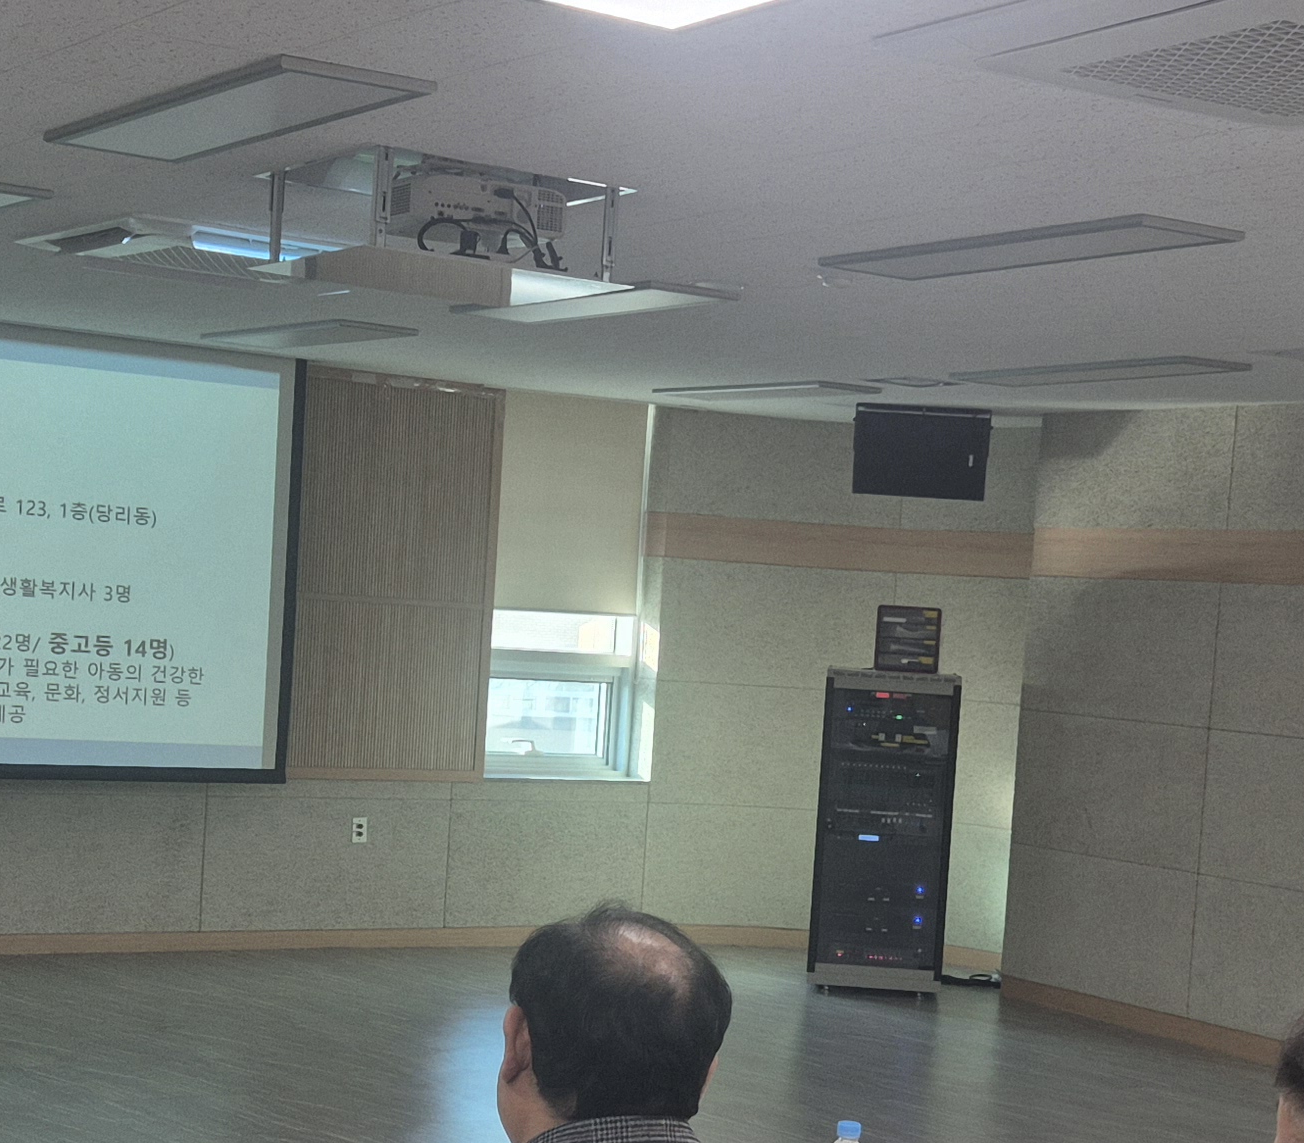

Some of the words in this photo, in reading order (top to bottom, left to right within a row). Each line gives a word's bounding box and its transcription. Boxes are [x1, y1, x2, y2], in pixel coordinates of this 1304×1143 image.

[16, 499, 51, 520] 123,
[59, 502, 158, 529] 1층(당리동)
[0, 576, 97, 602] 생활복지사
[103, 584, 132, 604] 3명
[48, 631, 114, 658] 중고등
[123, 637, 175, 662] 14명)
[23, 657, 79, 680] 필요한
[87, 660, 143, 683] 아동의
[150, 664, 205, 686] 건강한
[44, 682, 86, 705] 문화,
[93, 685, 167, 707] 정서지원
[174, 688, 192, 708] 등
